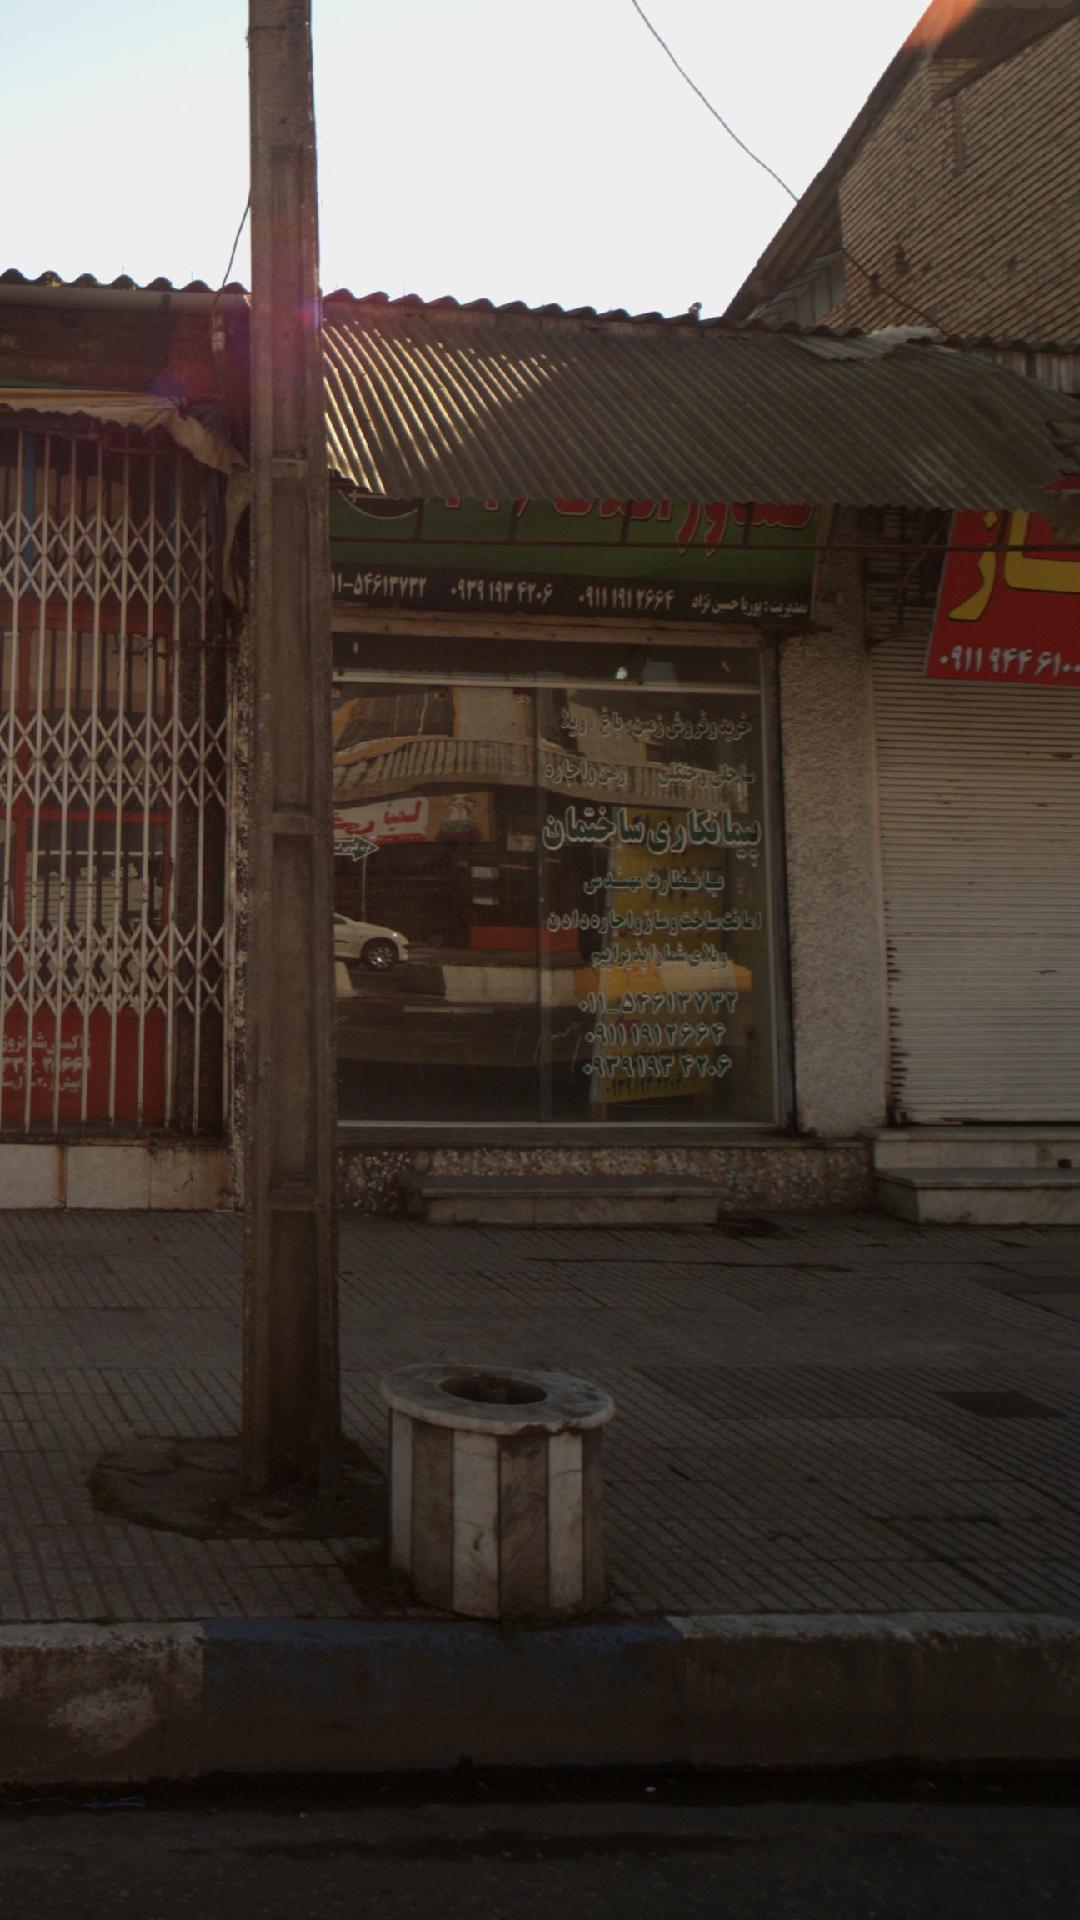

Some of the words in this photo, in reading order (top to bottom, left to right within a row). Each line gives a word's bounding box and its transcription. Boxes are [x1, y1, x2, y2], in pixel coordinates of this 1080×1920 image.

[541, 805, 646, 851] ساختمان
[646, 807, 763, 868] پیمانکاری
[647, 868, 702, 896] نظارت
[702, 870, 726, 898] با
